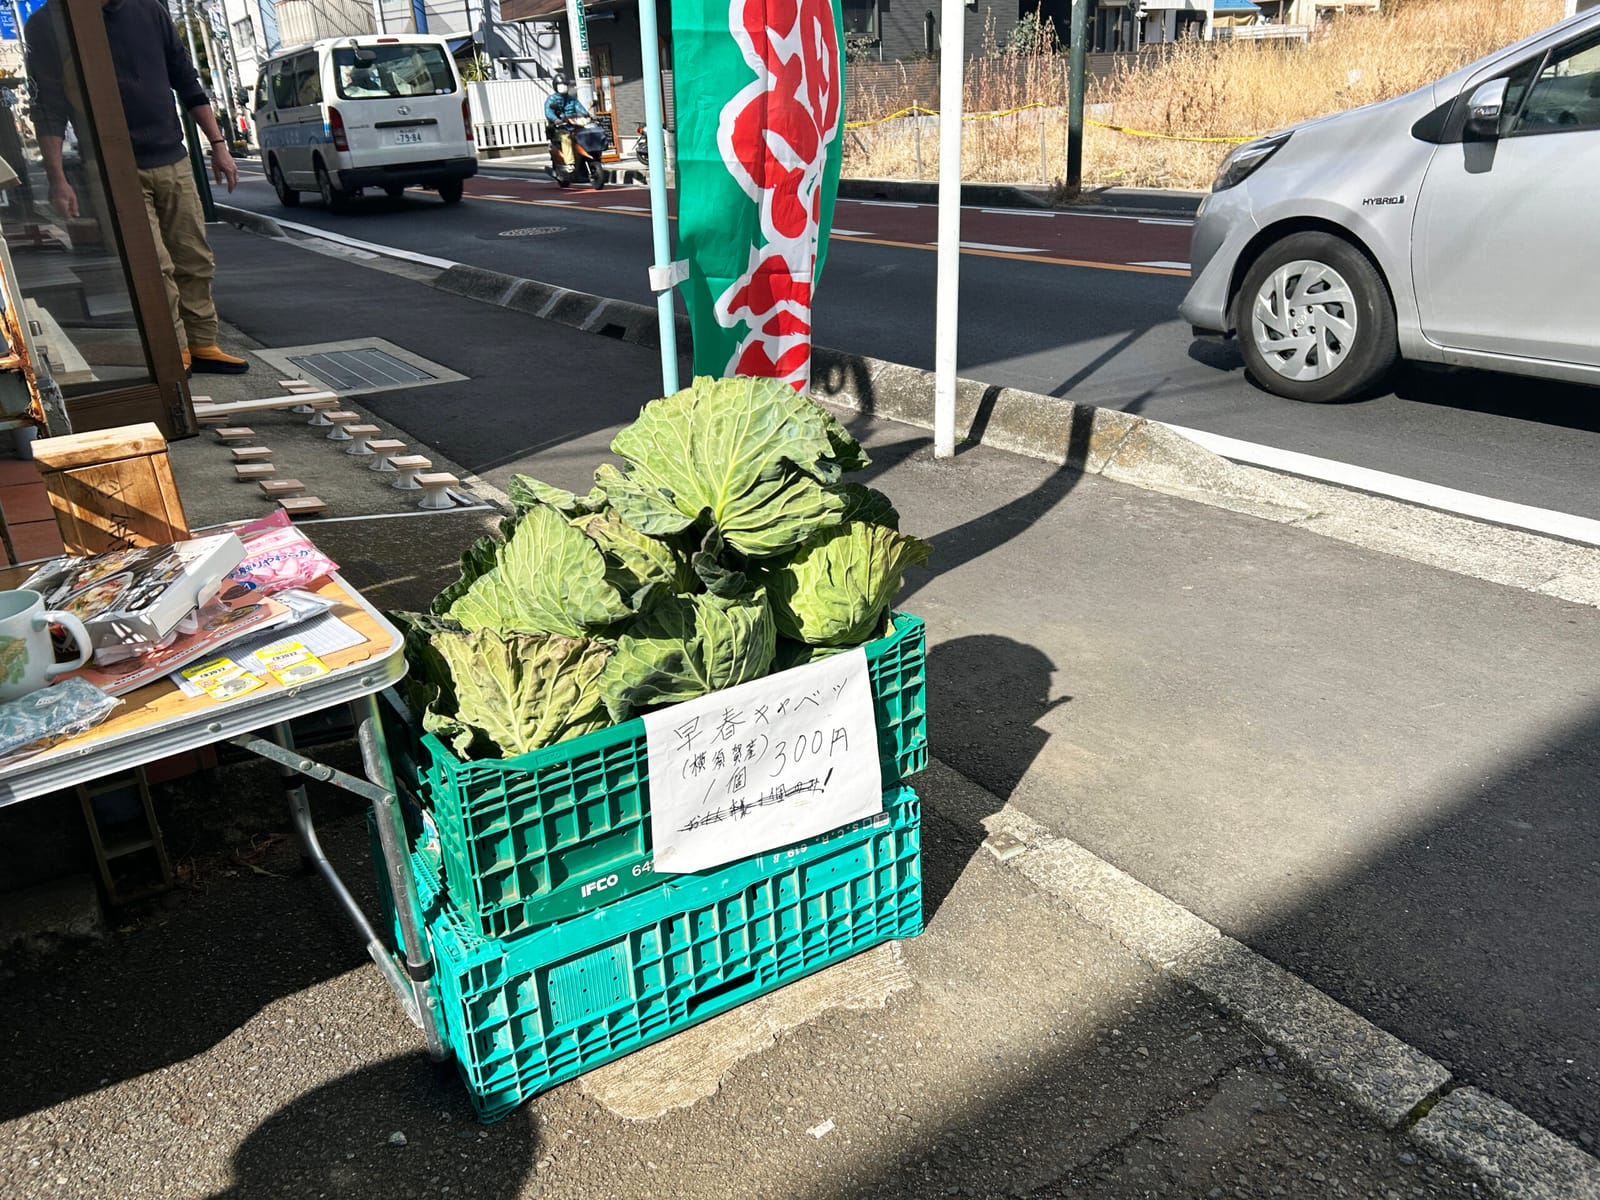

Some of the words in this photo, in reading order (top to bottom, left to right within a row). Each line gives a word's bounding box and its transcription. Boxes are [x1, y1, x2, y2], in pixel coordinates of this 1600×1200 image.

[1362, 196, 1398, 206] HYBRID
[673, 677, 849, 752] 早春キャベツ
[769, 727, 849, 778] 300円
[581, 873, 619, 898] IFCO
